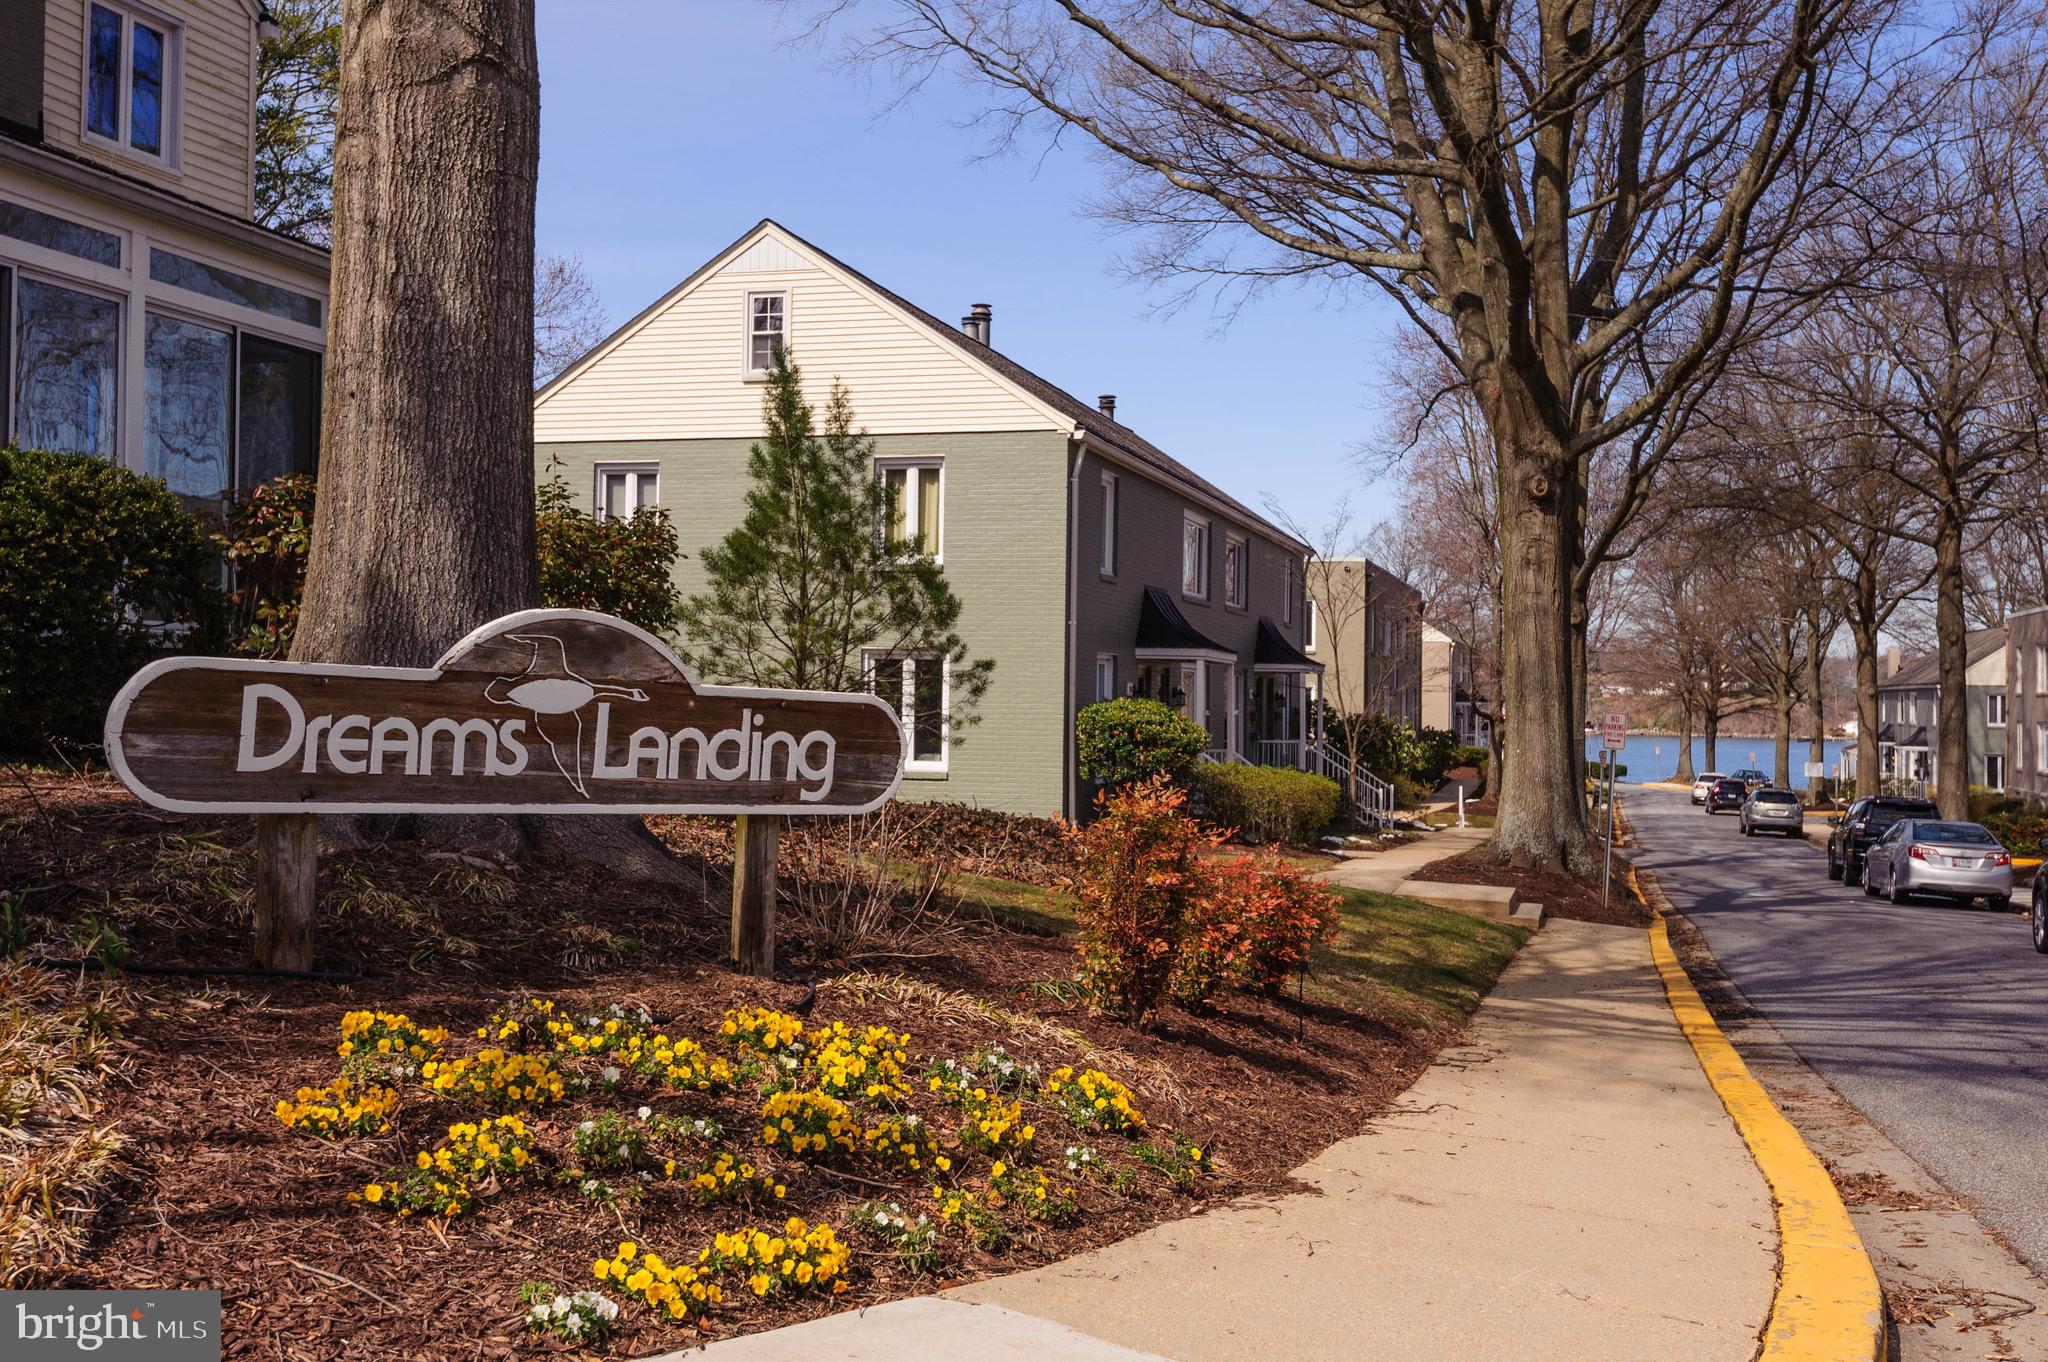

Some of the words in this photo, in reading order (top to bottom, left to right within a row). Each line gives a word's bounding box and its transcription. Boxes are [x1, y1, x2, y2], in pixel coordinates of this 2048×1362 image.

[1611, 715, 1620, 723] NO
[1604, 723, 1626, 731] PARKING
[592, 702, 837, 802] Landing
